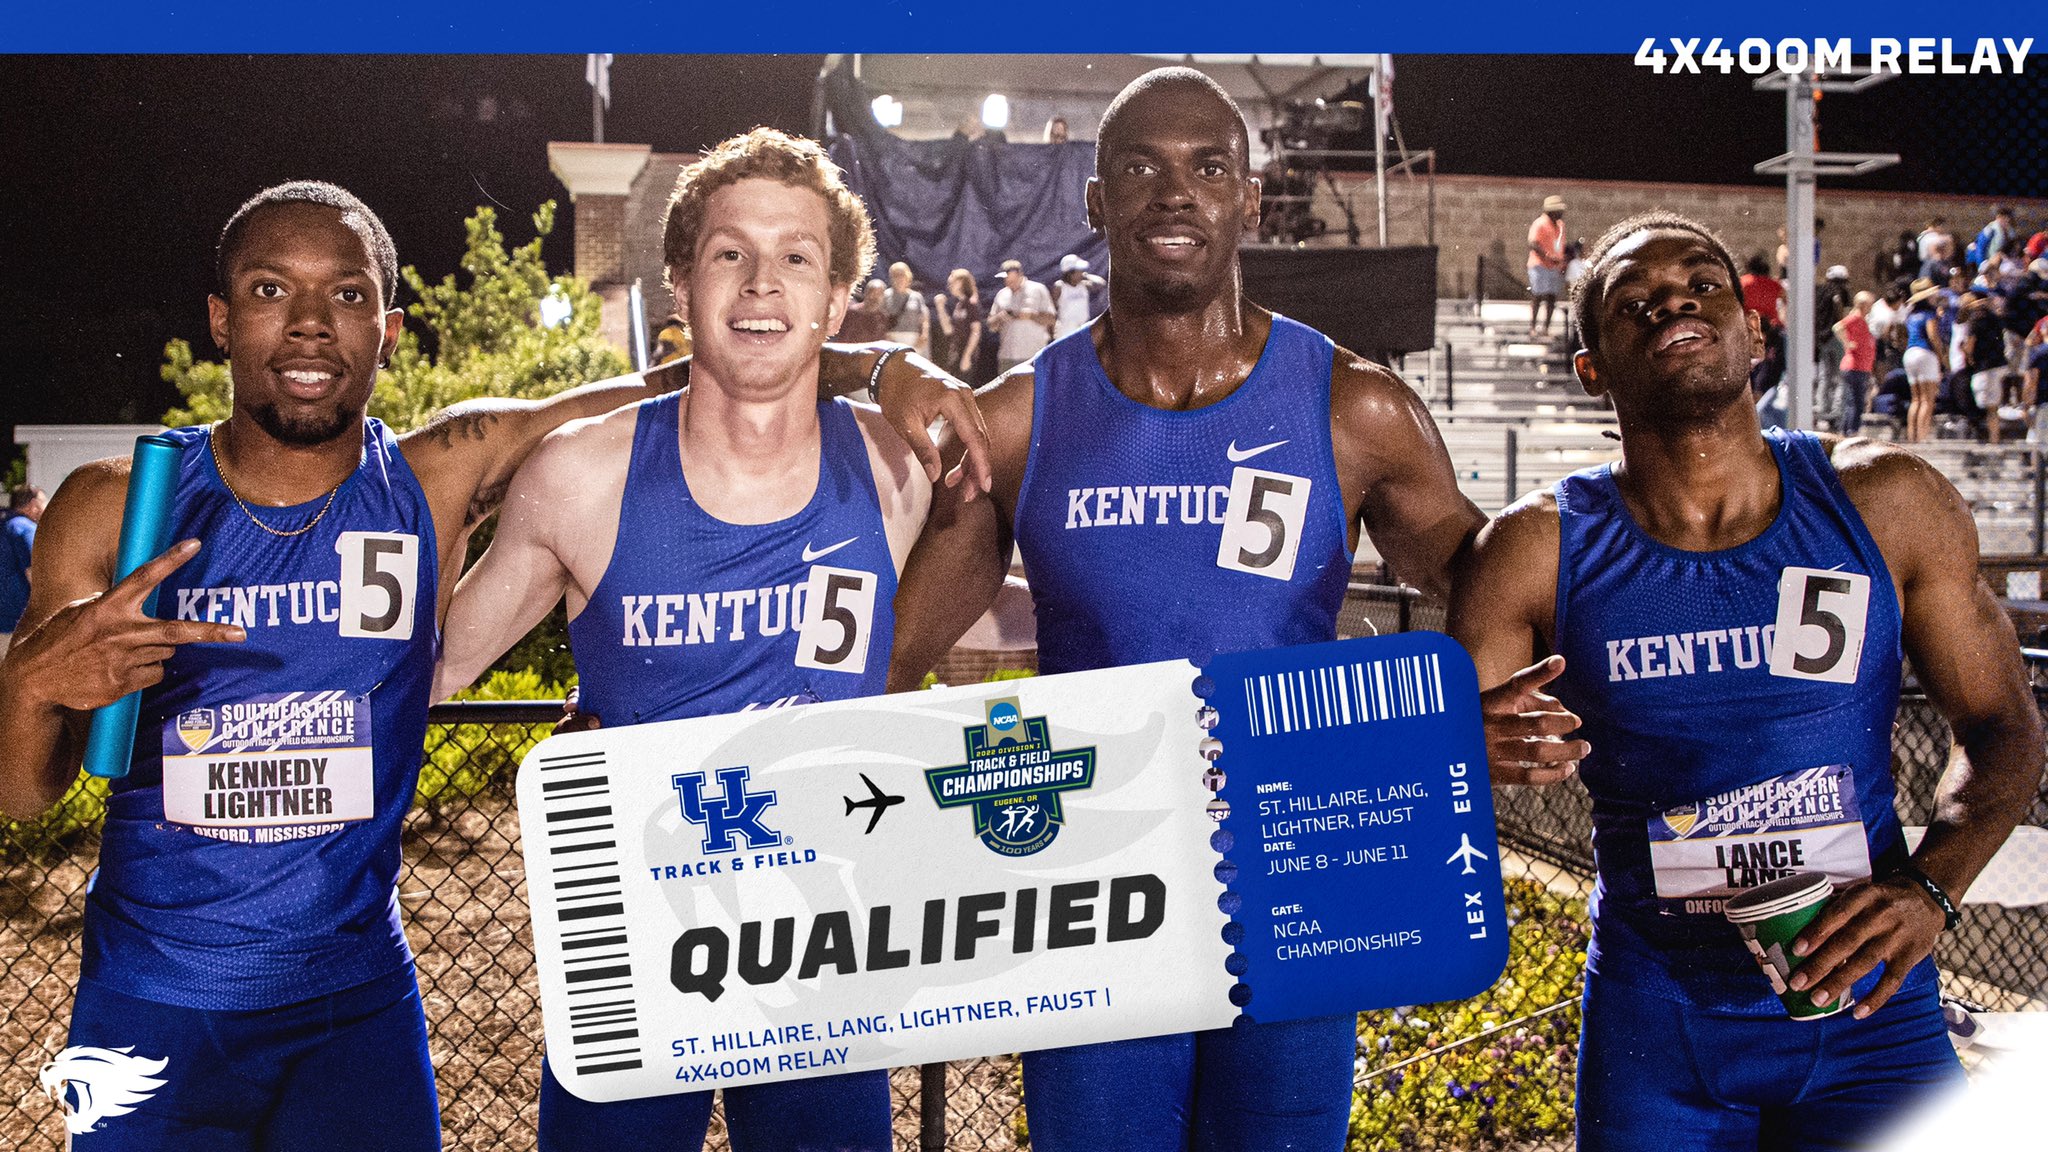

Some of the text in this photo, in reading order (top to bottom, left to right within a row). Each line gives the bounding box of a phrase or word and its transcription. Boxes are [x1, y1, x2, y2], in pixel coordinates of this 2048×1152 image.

[1065, 485, 1230, 530] KENTUC
[1237, 475, 1293, 569] 5
[360, 537, 404, 633] 5
[177, 580, 342, 628] KENTUC
[813, 573, 863, 665] 5
[1792, 574, 1851, 675] 5
[221, 700, 354, 722] SOUTHEASTERN
[222, 717, 355, 739] CONFERENCE
[301, 734, 355, 744] CHAMPIONSHIPS
[208, 757, 328, 790] KENNEDY
[204, 787, 333, 819] LIGHTNER
[1706, 793, 1843, 824] CONFERENCE
[1790, 810, 1845, 826] CHAMPIONSHIPS
[193, 826, 253, 844] OXFORD,
[1715, 839, 1804, 869] LANCE
[1684, 899, 1725, 914] OXFO
